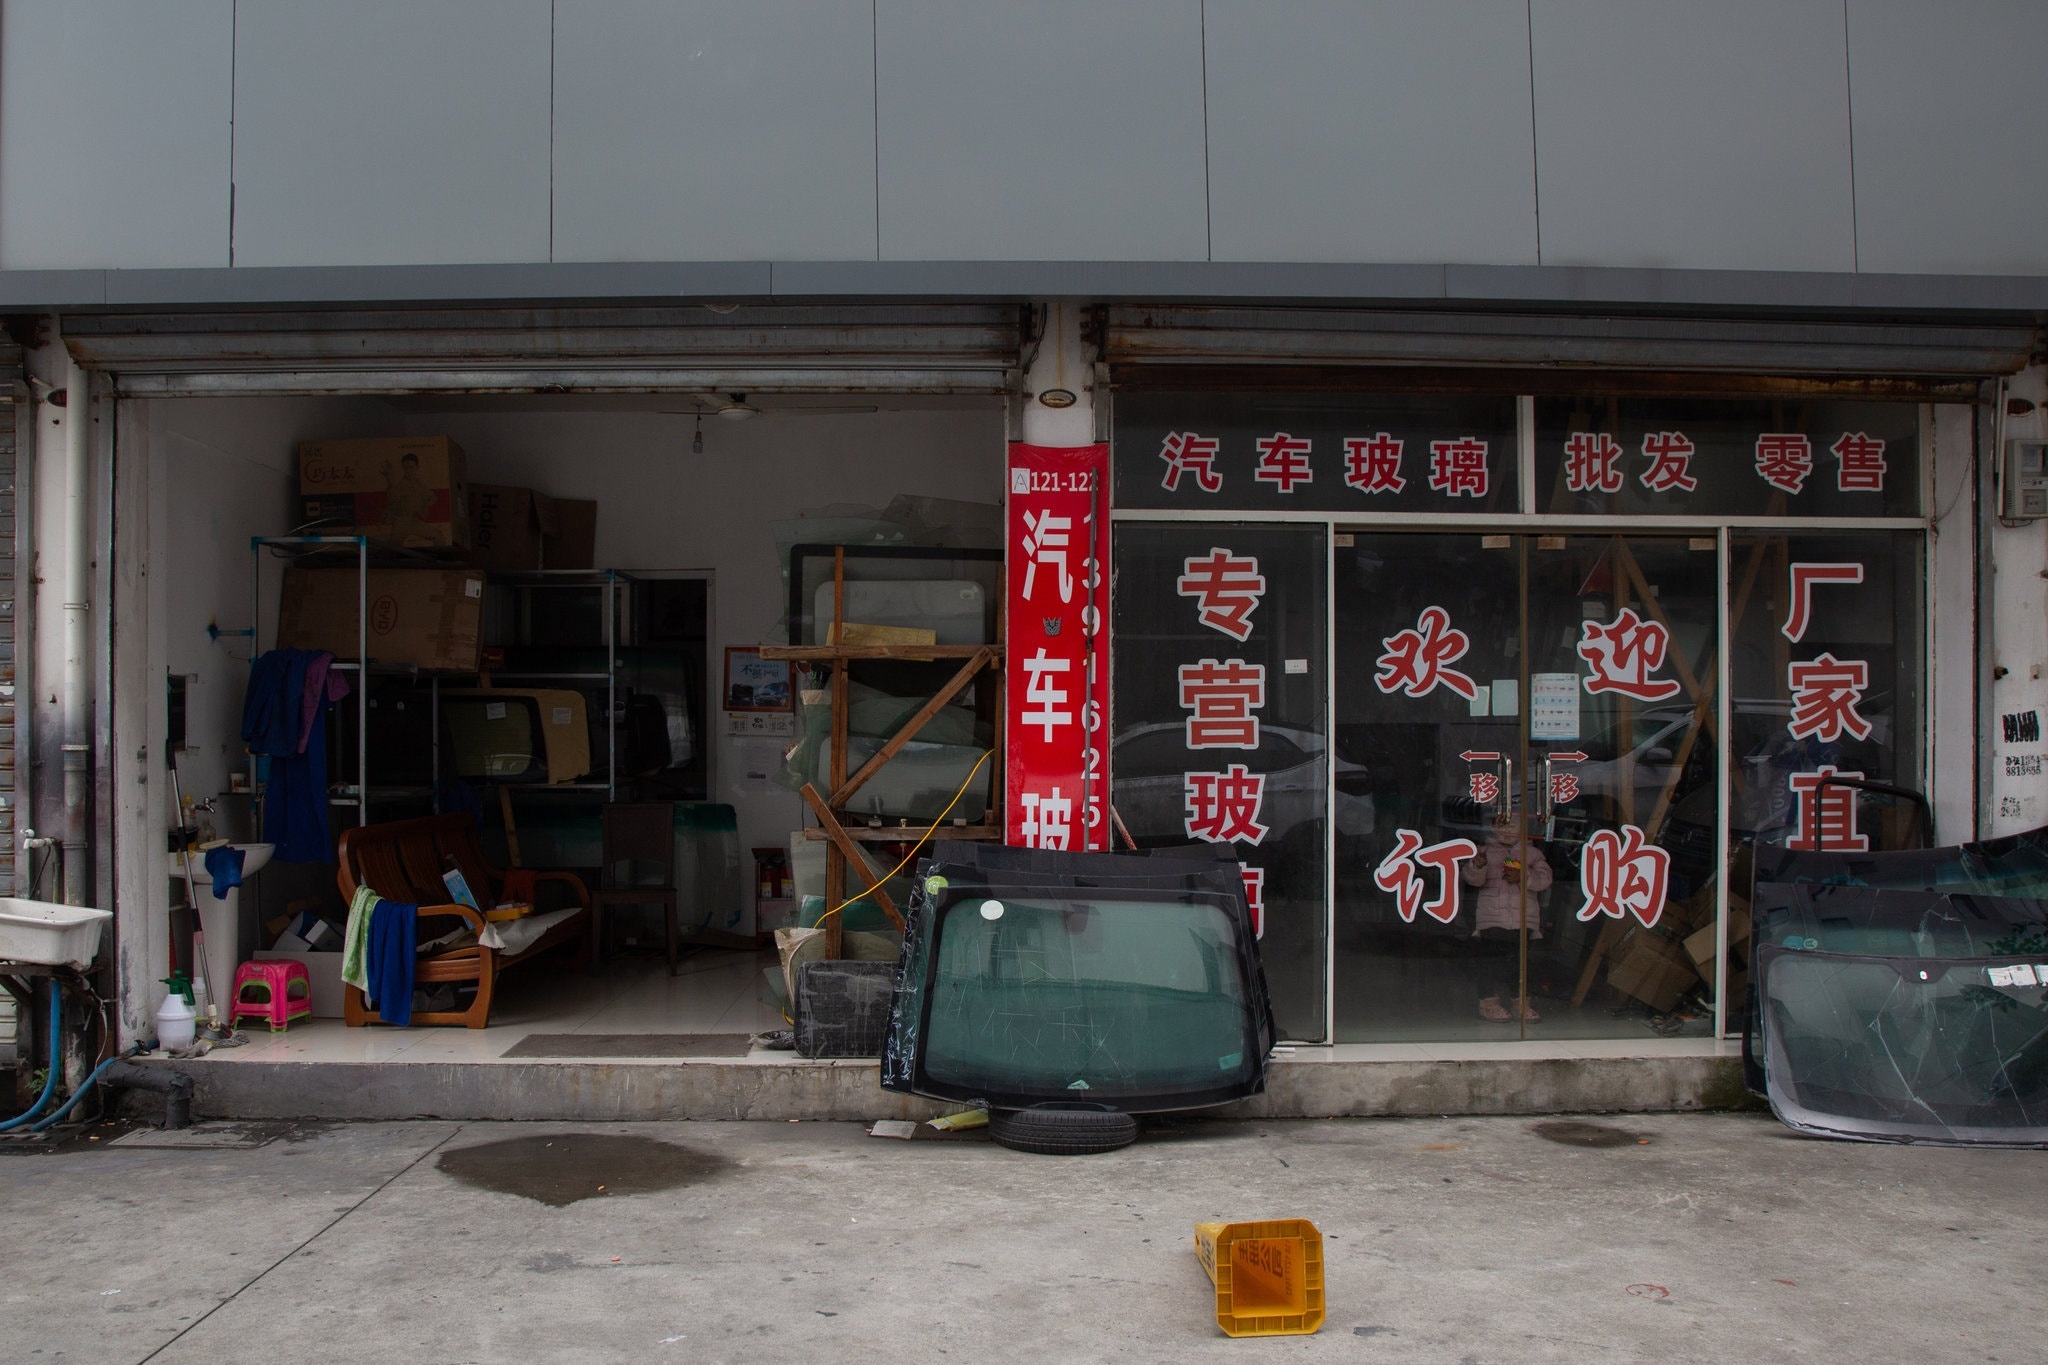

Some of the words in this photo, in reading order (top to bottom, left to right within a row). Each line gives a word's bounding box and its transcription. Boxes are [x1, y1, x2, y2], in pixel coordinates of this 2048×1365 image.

[1159, 431, 1490, 498] 汽车玻璃
[1564, 431, 1698, 493] 批发
[1754, 431, 1887, 495] 零售
[478, 493, 499, 550] Haier
[1021, 509, 1074, 851] 汽车玻
[1081, 512, 1101, 850] 391625
[1374, 605, 1681, 702] 欢迎
[1782, 562, 1873, 852] 厂家直
[1469, 772, 1499, 804] 移
[1550, 772, 1580, 804] 移
[1374, 824, 1672, 929] 订购
